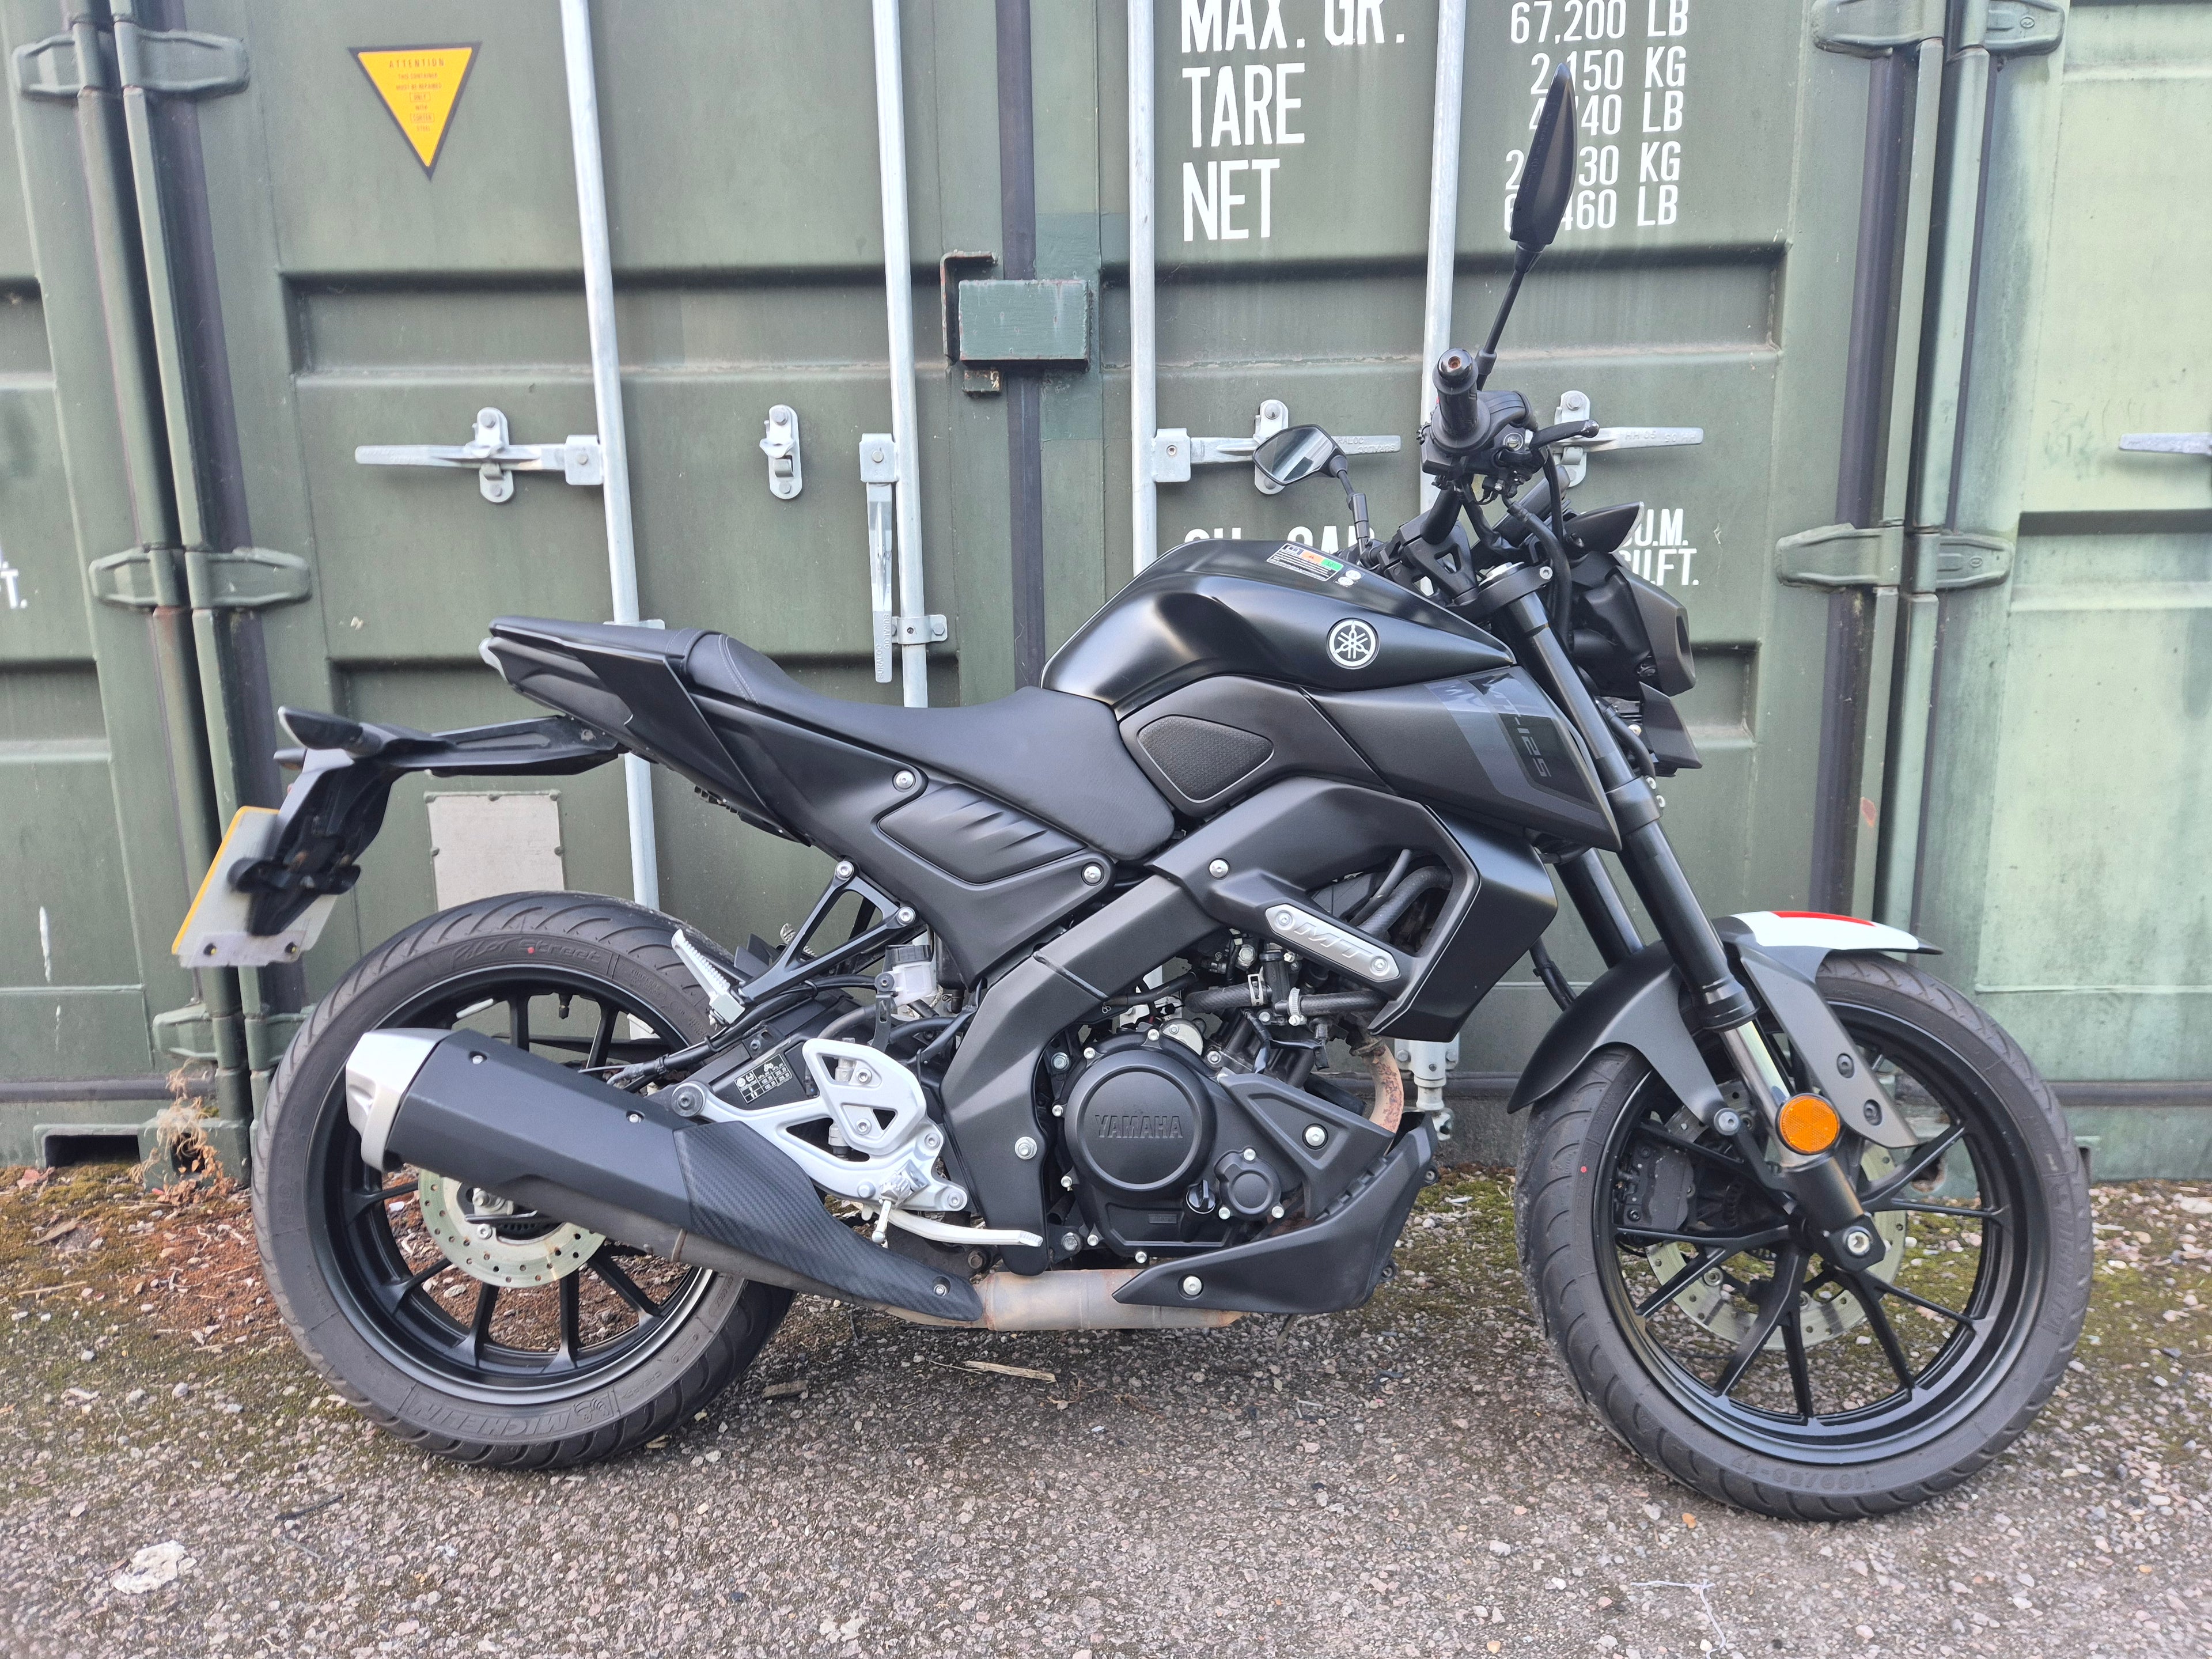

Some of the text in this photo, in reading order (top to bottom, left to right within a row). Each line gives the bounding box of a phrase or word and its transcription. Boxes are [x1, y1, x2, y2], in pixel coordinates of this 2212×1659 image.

[1181, 0, 1404, 53] MAX. GR.
[1510, 0, 1688, 44] 67,200 LB
[389, 58, 445, 68] ATTENTION
[1531, 46, 1686, 94] 2150 KG
[1182, 62, 1305, 148] TARE
[1642, 90, 1683, 132] LB
[1639, 141, 1681, 183] KG
[1183, 158, 1280, 241] NET
[1637, 184, 1678, 226] LB
[1293, 922, 1374, 959] MT
[1094, 1115, 1183, 1139] YAMAHA
[412, 1402, 570, 1435] MICHELIN
